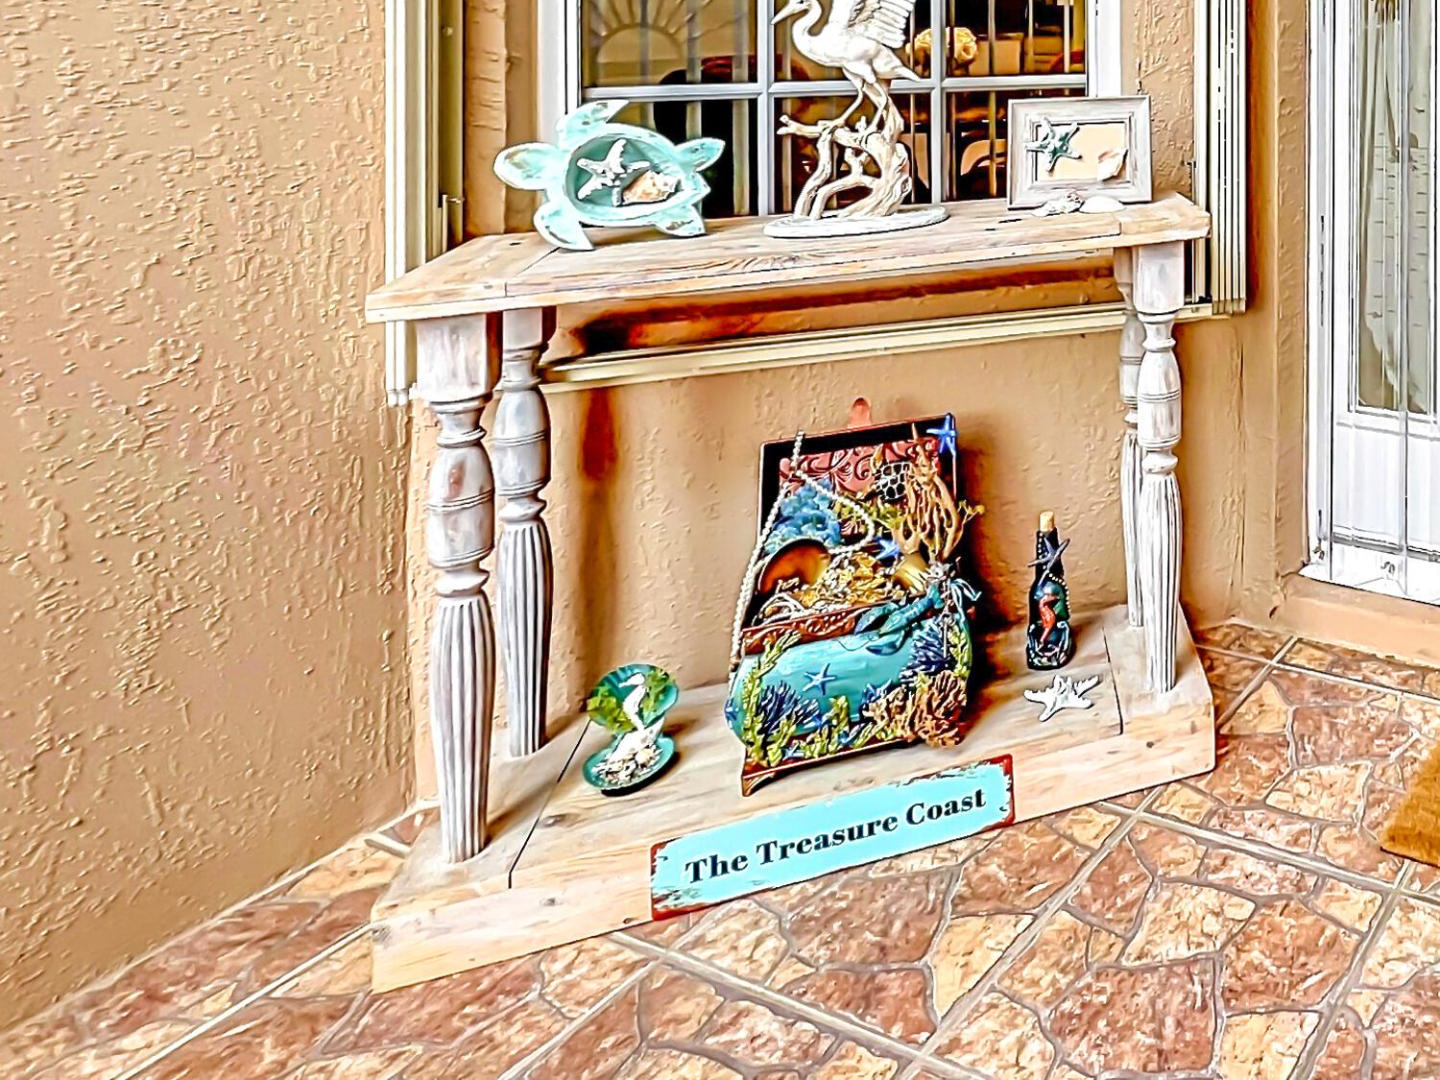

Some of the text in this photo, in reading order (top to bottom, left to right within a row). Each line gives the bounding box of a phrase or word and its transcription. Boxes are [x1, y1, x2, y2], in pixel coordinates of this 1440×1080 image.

[685, 788, 988, 884] The Treasure Coast
